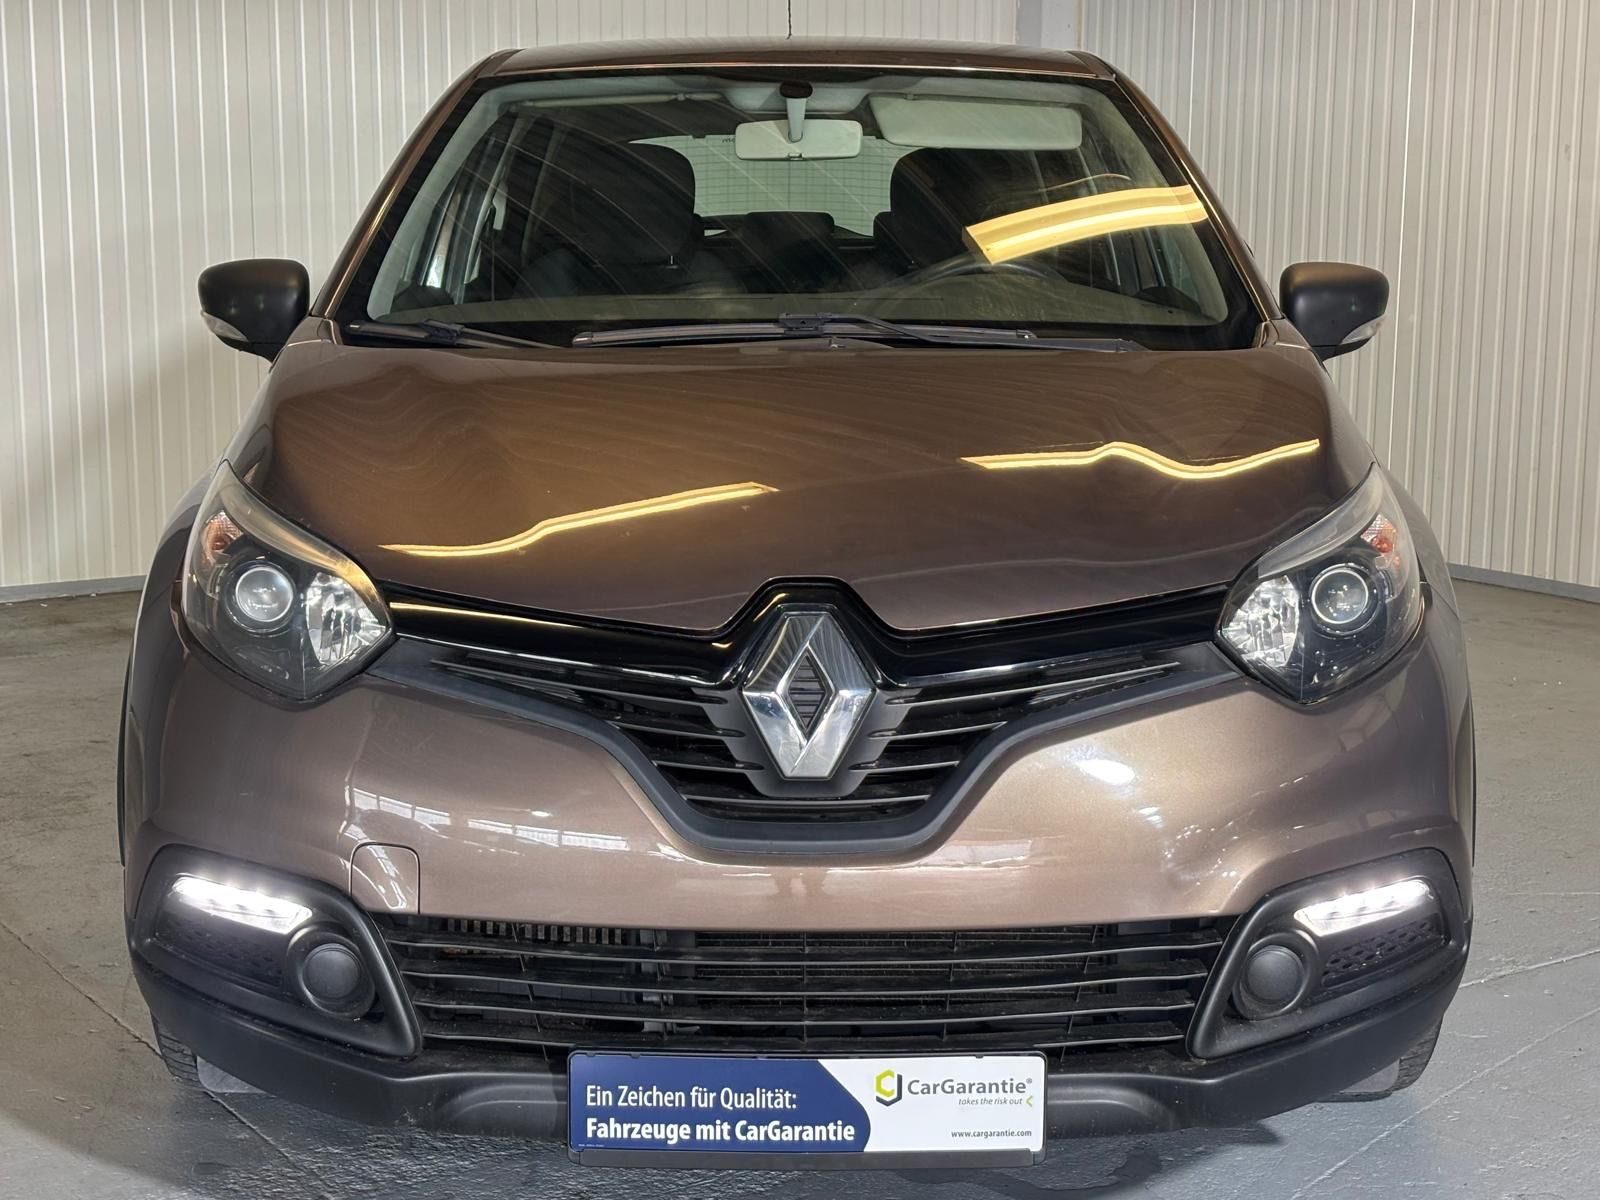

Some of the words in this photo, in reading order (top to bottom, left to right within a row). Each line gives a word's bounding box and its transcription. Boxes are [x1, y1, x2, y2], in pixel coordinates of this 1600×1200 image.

[586, 1085, 613, 1106] Ein
[617, 1085, 686, 1107] Zeichen
[690, 1086, 717, 1108] für
[720, 1087, 797, 1110] Qualität:
[958, 1097, 979, 1105] takes
[980, 1096, 994, 1105] the
[994, 1096, 1008, 1105] risk
[1008, 1097, 1023, 1105] out
[586, 1117, 691, 1145] Fahrzeuge
[695, 1119, 731, 1141] mit
[735, 1119, 855, 1141] CarGarantie
[951, 1128, 1032, 1139] www.cargarantie.com
